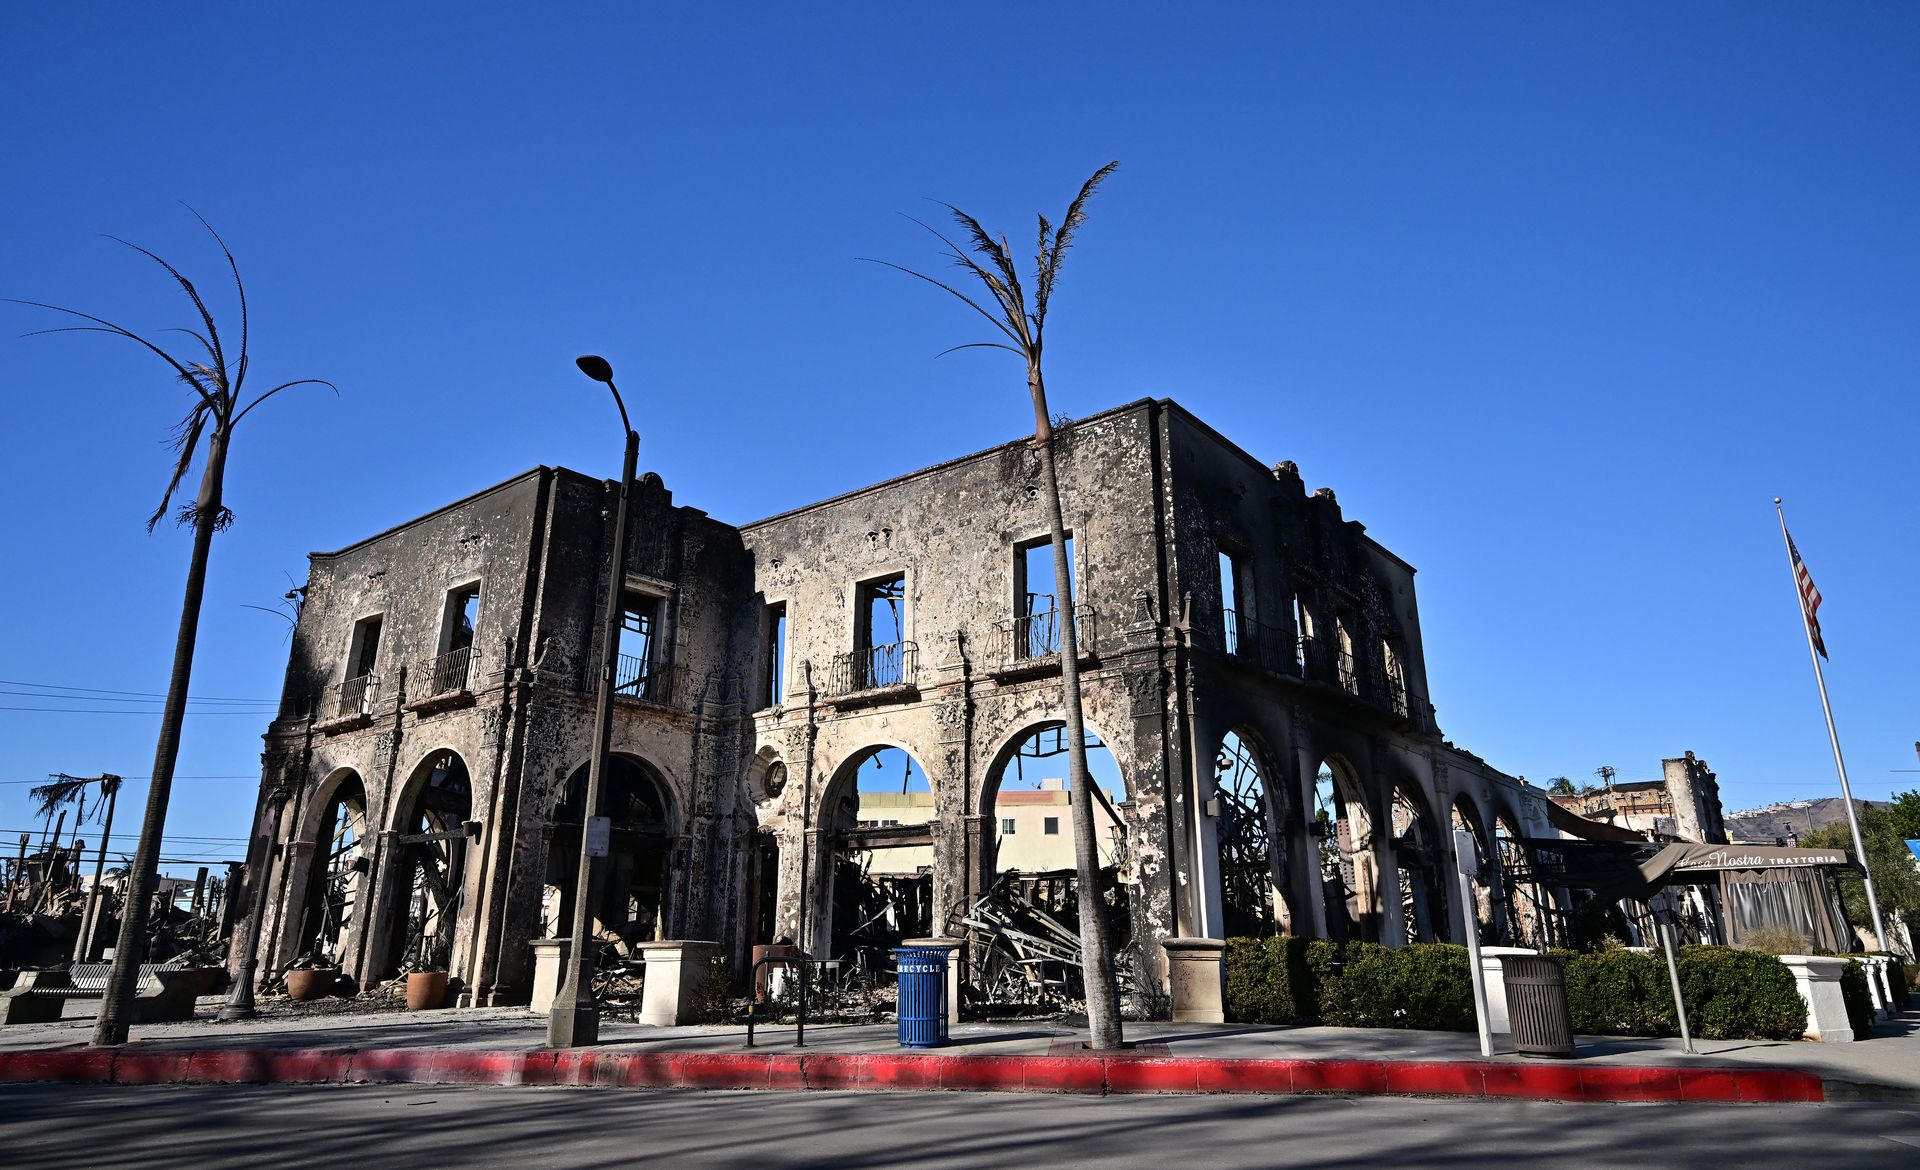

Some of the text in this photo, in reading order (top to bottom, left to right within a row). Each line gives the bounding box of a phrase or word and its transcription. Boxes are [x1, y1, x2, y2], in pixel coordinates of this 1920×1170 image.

[1709, 851, 1764, 867] Nostra
[1769, 856, 1838, 865] TRATTORIA
[898, 965, 942, 973] RECYCLE
